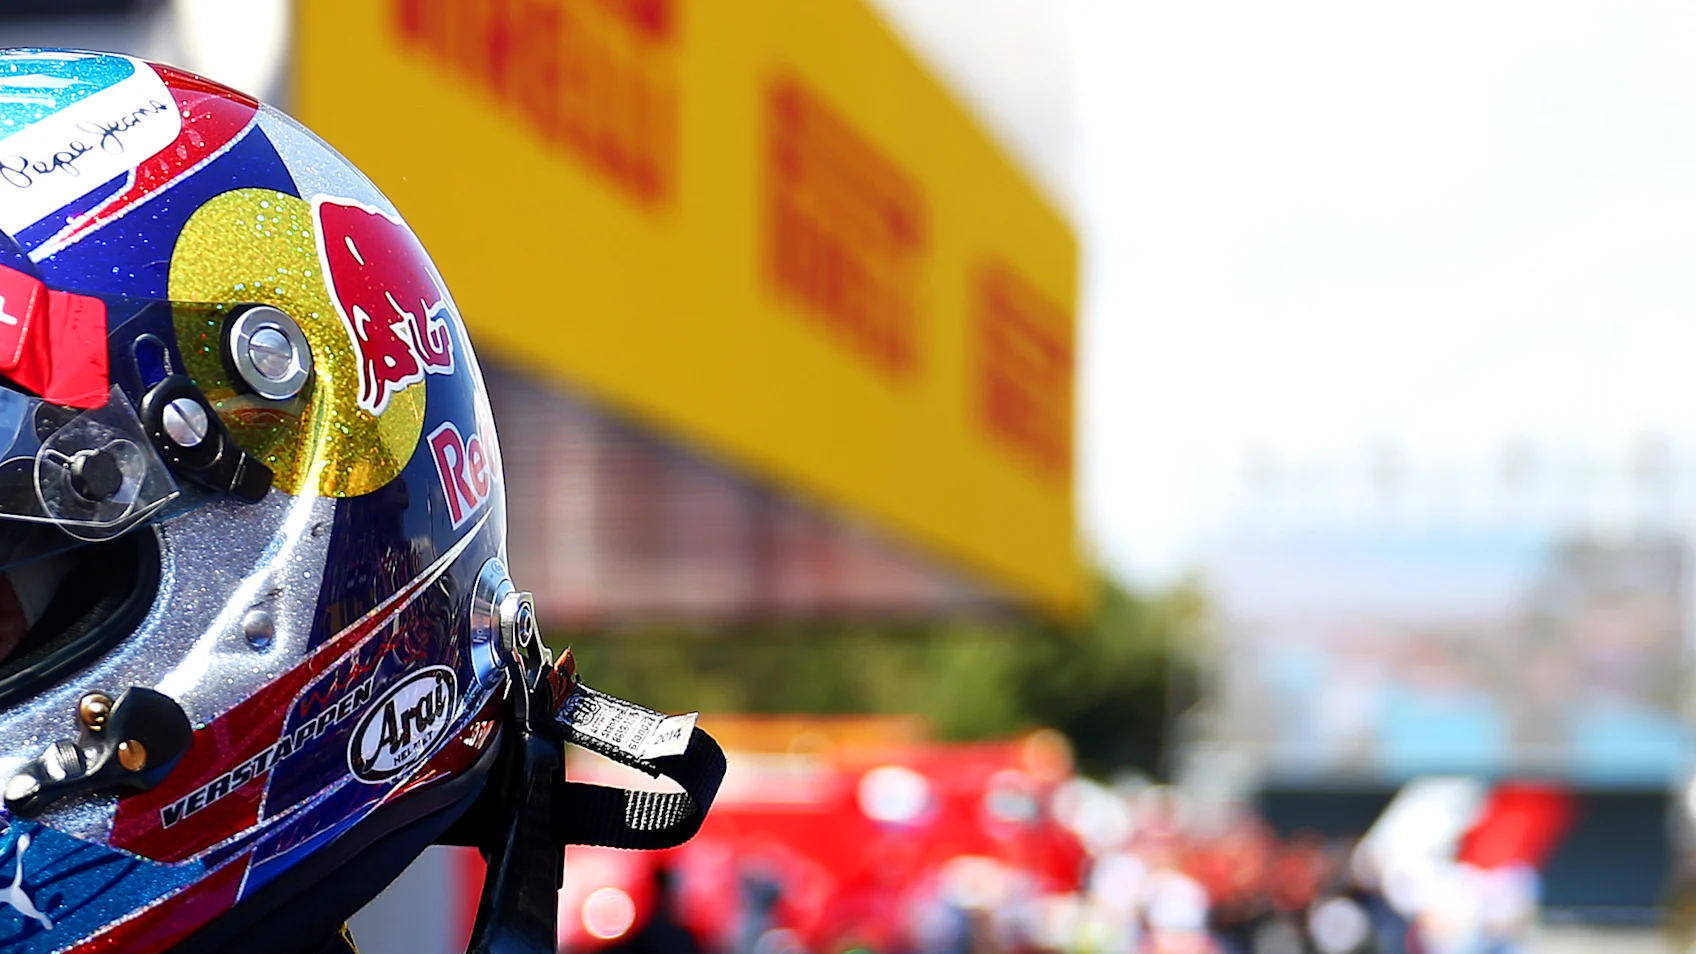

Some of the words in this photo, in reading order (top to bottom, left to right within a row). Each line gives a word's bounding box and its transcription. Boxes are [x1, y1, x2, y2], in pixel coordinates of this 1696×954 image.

[76, 99, 168, 155] Jeans
[161, 678, 374, 829] VERSTAPPEN
[362, 671, 446, 774] Arai
[654, 728, 682, 746] 2014
